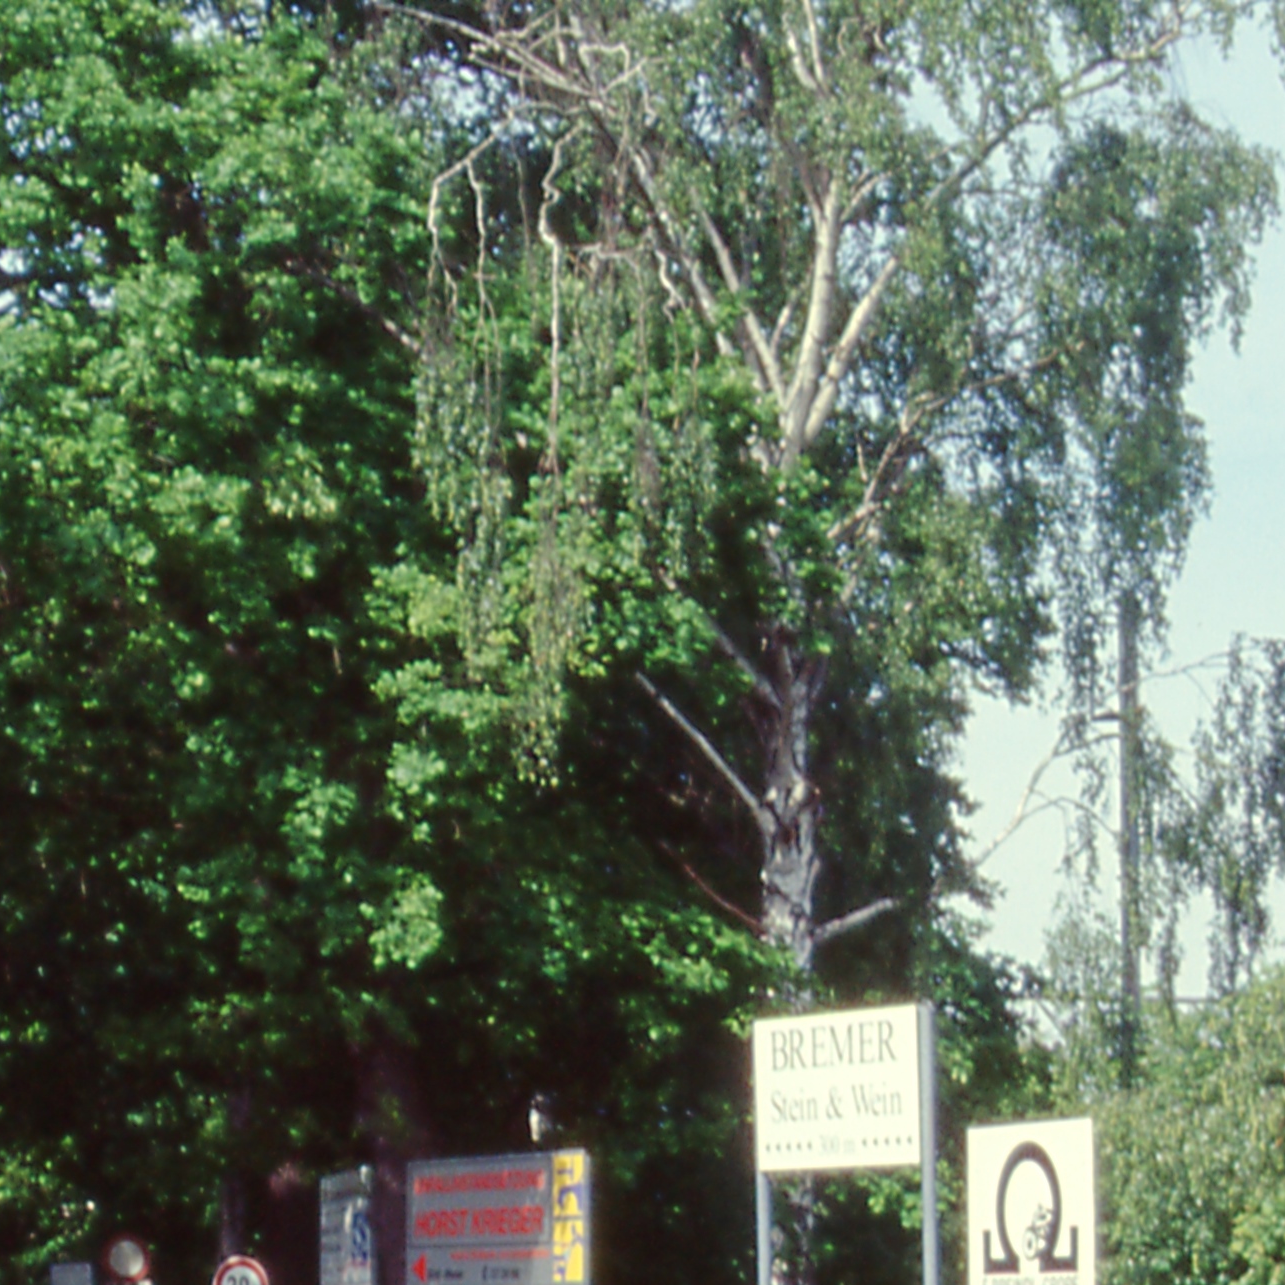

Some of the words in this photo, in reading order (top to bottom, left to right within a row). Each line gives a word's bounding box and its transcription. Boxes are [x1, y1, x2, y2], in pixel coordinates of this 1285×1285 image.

[771, 1019, 897, 1072] BREMER
[771, 1087, 819, 1124] Stein
[825, 1085, 844, 1121] &
[852, 1081, 903, 1118] Wein
[414, 1208, 468, 1238] HORST
[471, 1205, 546, 1236] KRIEGER
